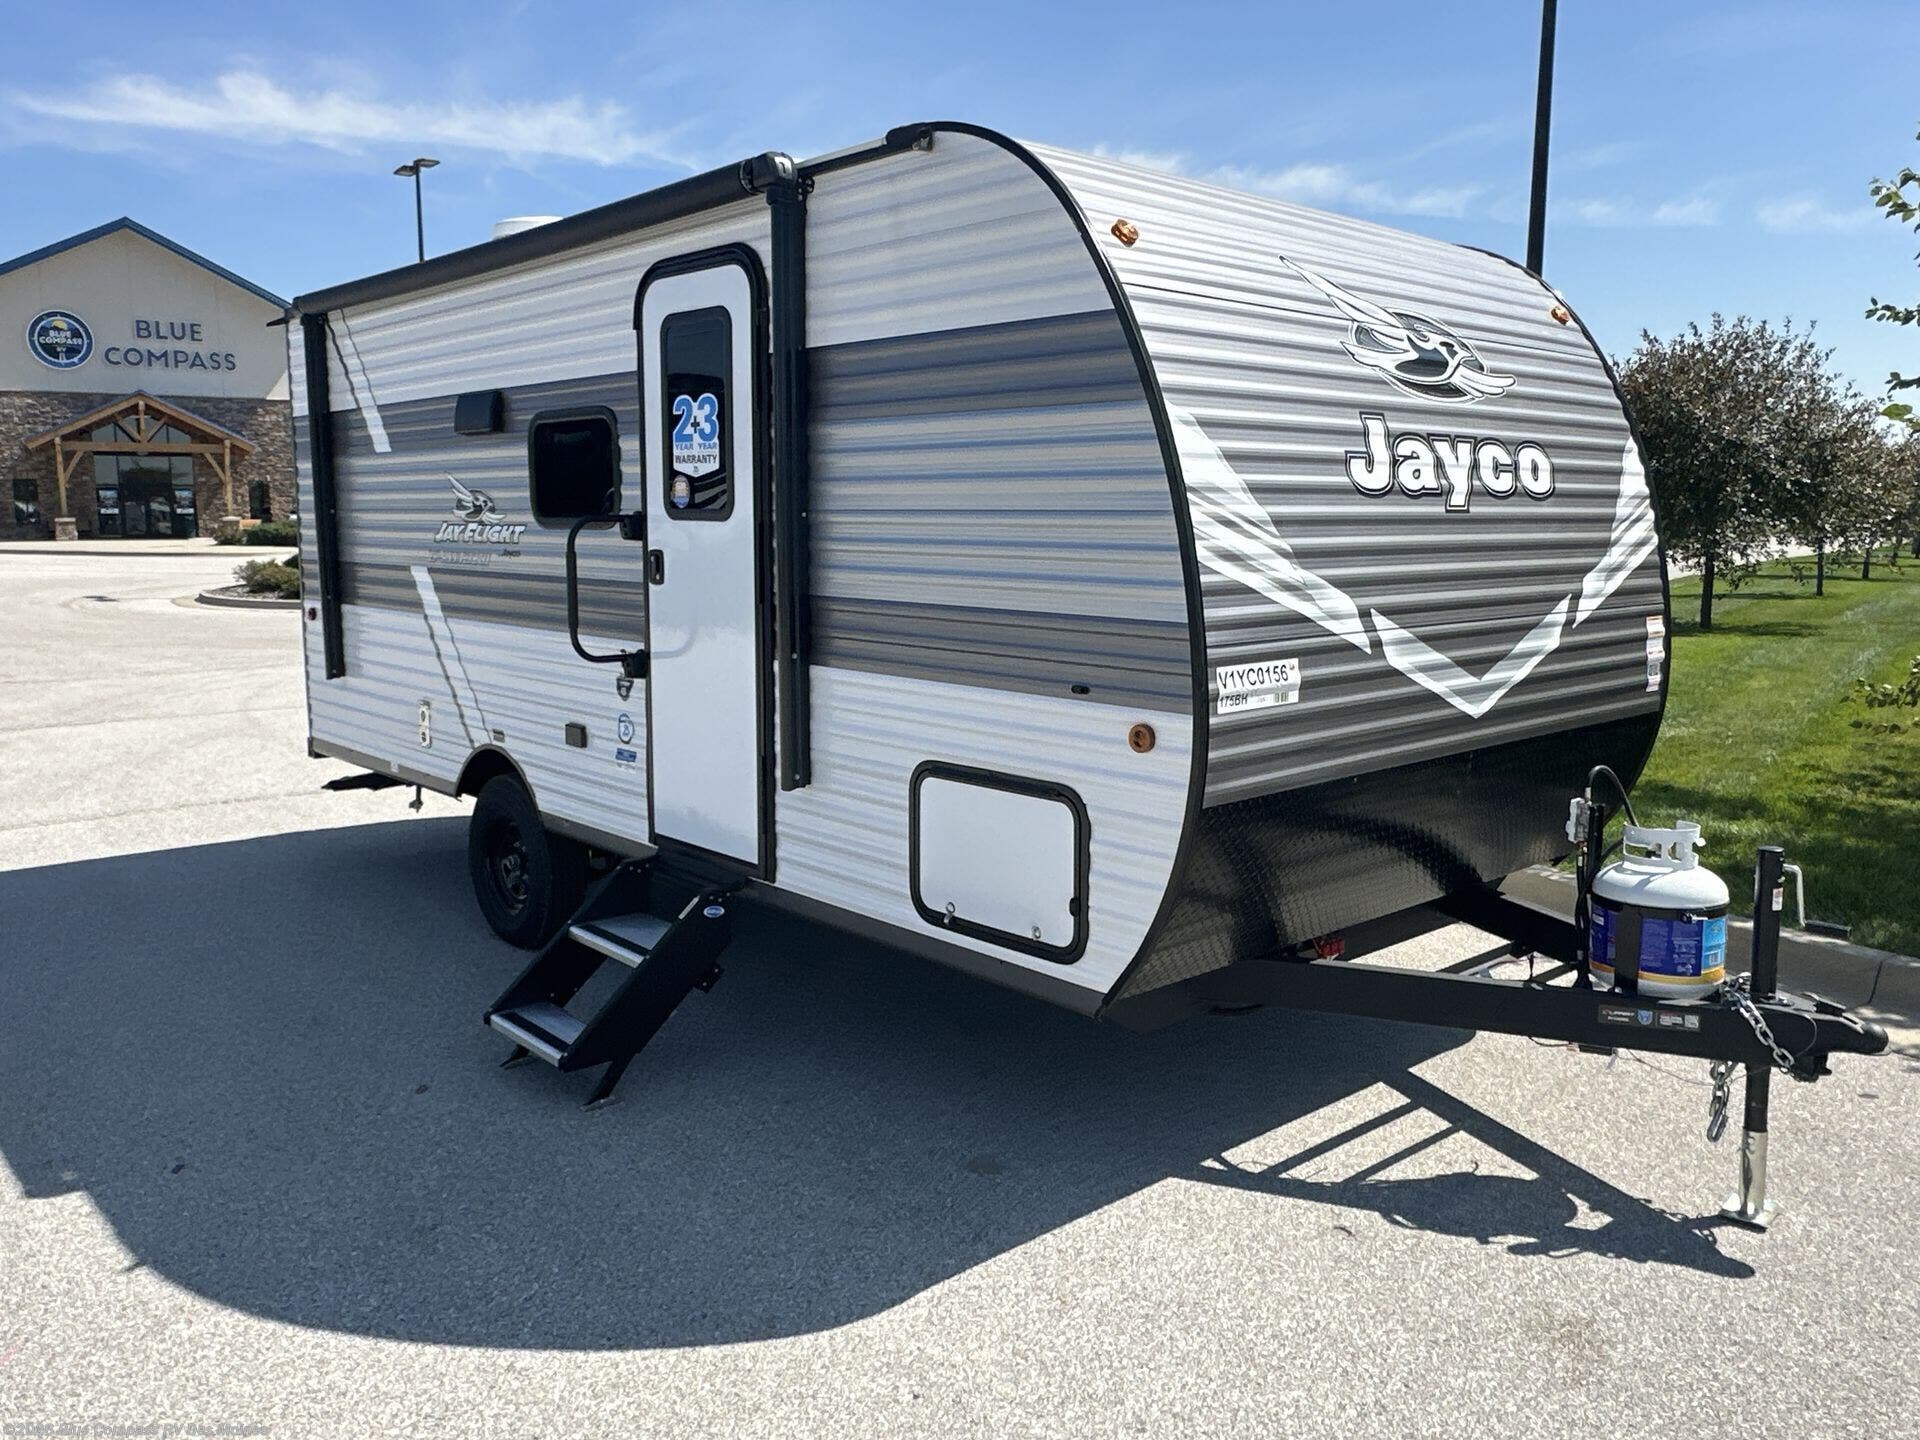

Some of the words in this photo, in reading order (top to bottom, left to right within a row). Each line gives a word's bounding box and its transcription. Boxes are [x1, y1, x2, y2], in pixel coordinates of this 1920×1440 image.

[49, 329, 71, 338] BLUE
[135, 319, 203, 342] BLUE
[39, 336, 82, 345] COMPASS
[104, 347, 236, 371] COMPASS
[675, 443, 694, 451] YEAR
[698, 442, 717, 451] YEAR
[675, 454, 717, 464] WARRANTY
[1345, 411, 1555, 513] Jayco
[1219, 664, 1289, 690] V1YC0156
[1219, 693, 1248, 708] 175BH
